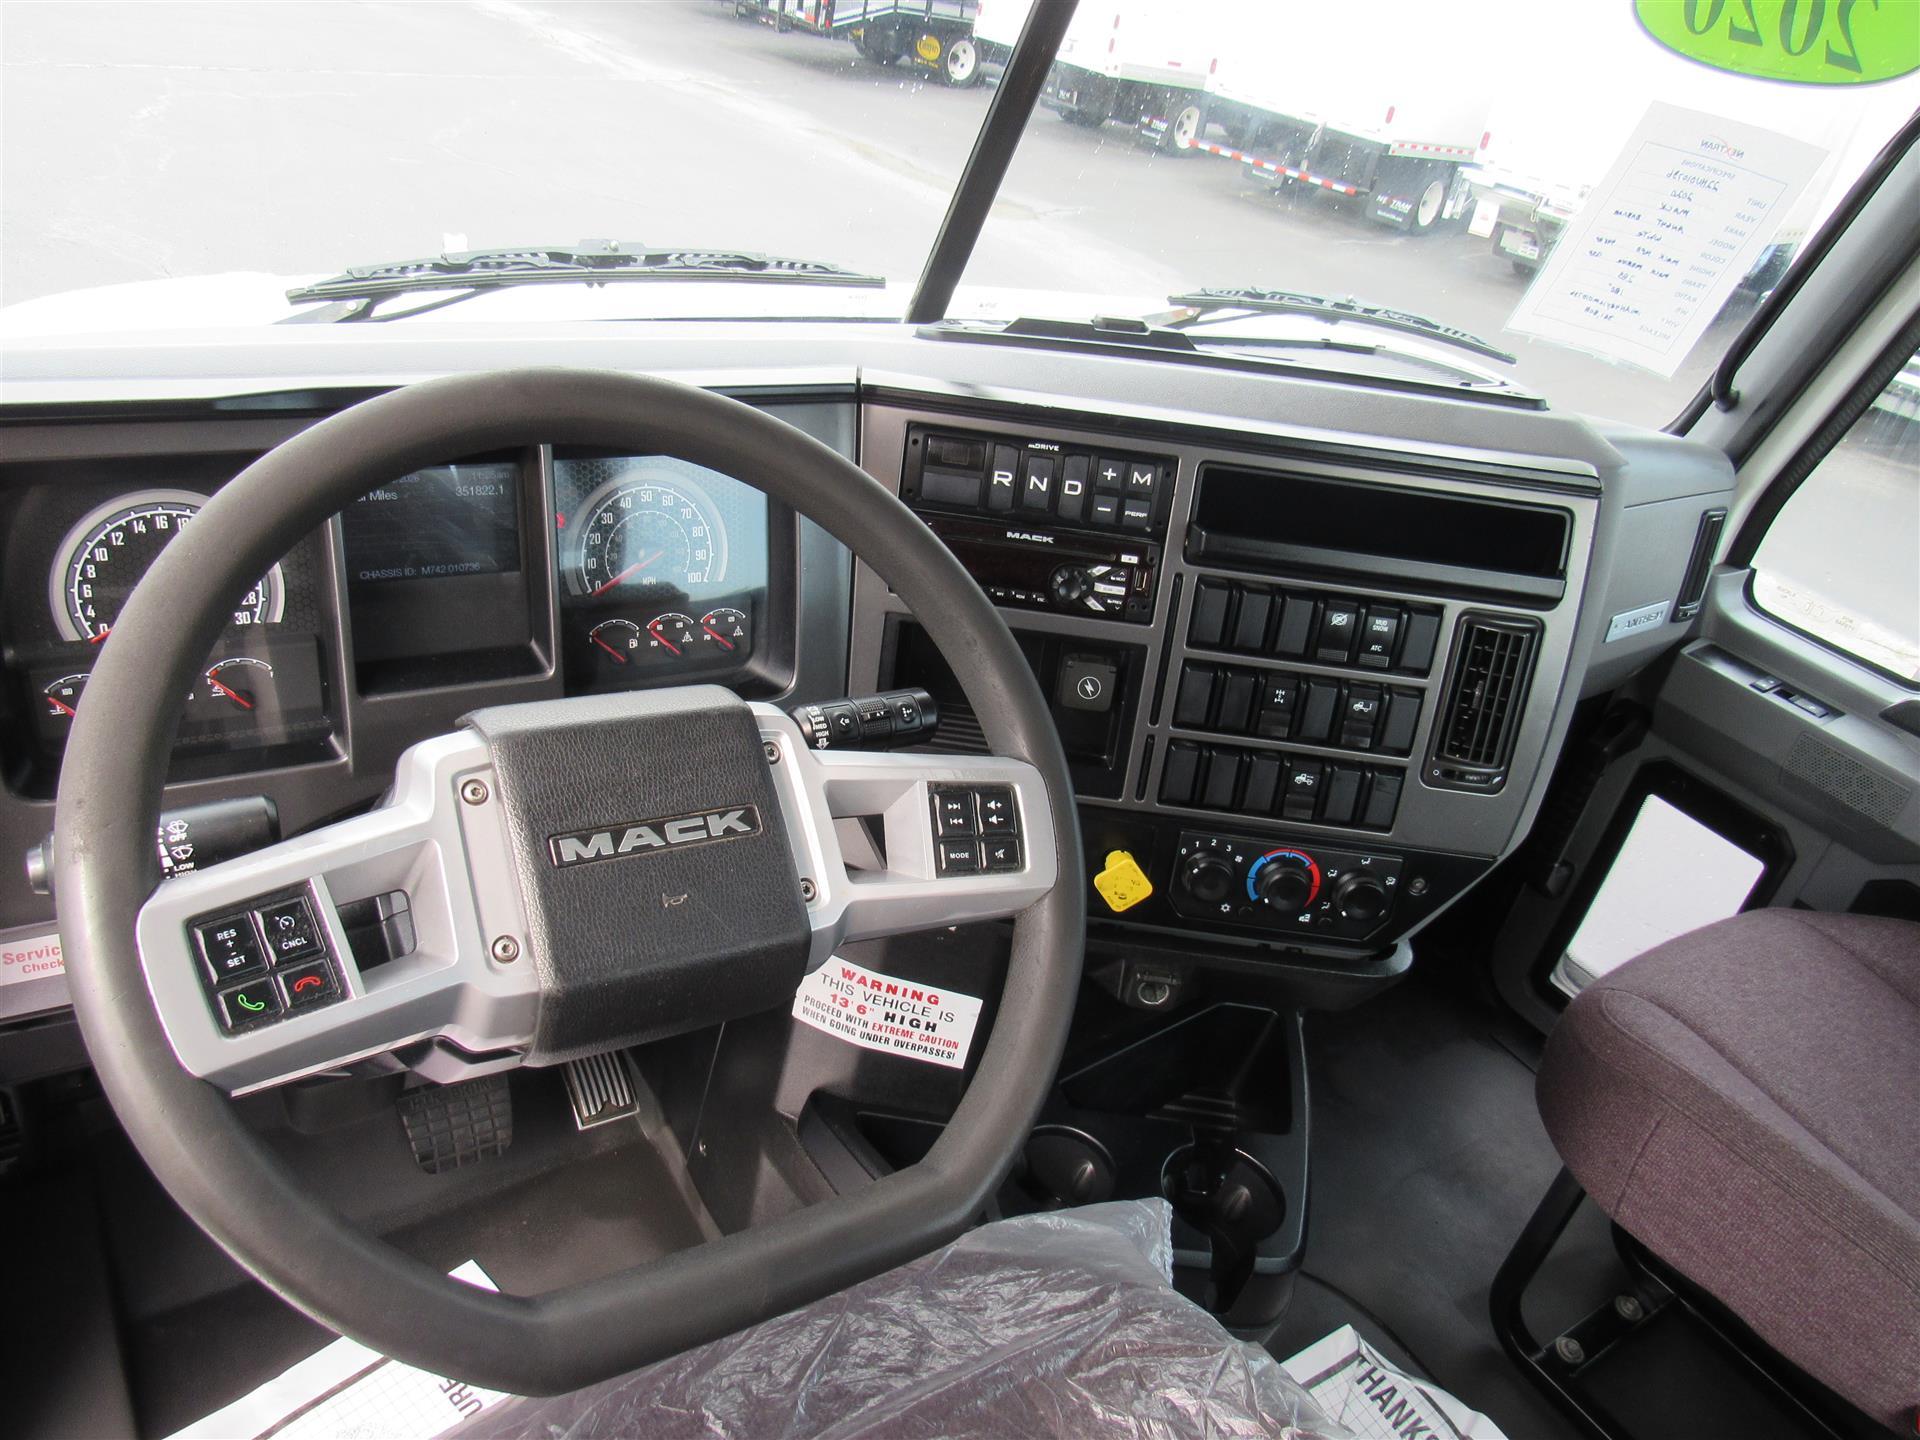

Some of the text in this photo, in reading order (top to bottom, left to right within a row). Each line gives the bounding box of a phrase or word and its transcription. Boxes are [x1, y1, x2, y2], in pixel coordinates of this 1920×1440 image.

[993, 470, 1013, 487] R
[1029, 476, 1048, 492] N
[1132, 471, 1151, 486] M
[369, 490, 398, 501] Miles
[456, 485, 504, 496] 351822.1
[1064, 480, 1082, 496] D
[641, 490, 653, 502] 50
[662, 495, 674, 506] 60
[620, 497, 631, 509] 40
[601, 512, 613, 525] 30
[680, 508, 692, 519] 70
[1125, 510, 1148, 518] PERF
[133, 520, 147, 534] 14
[155, 515, 169, 530] 16
[692, 526, 704, 537] 80
[1006, 531, 1054, 544] MACK
[111, 532, 125, 546] 12
[589, 533, 601, 545] 20
[94, 547, 108, 562] 10
[695, 549, 707, 561] 90
[587, 558, 597, 569] 10
[86, 564, 97, 579] 8
[360, 567, 402, 580] CHASSIS
[687, 572, 702, 584] 100
[82, 584, 92, 598] 6
[87, 605, 96, 618] 4
[234, 611, 251, 625] 30
[558, 809, 752, 862] MACK
[1211, 839, 1217, 847] 2
[1226, 844, 1232, 852] 3
[1181, 847, 1187, 855] 0
[174, 862, 195, 871] LOW
[216, 928, 237, 941] RES
[282, 936, 308, 950] CNCL
[2, 945, 62, 965] Servic
[226, 955, 246, 968] SET
[841, 966, 941, 1006] WARNING
[820, 972, 955, 1024] THIS VEHICLE IS
[804, 995, 960, 1050] PROCEED WITH EXTREME CAUTION
[884, 1011, 938, 1033] HIGH
[802, 1006, 956, 1061] WHEN GOING UNDER OVERPASSES!
